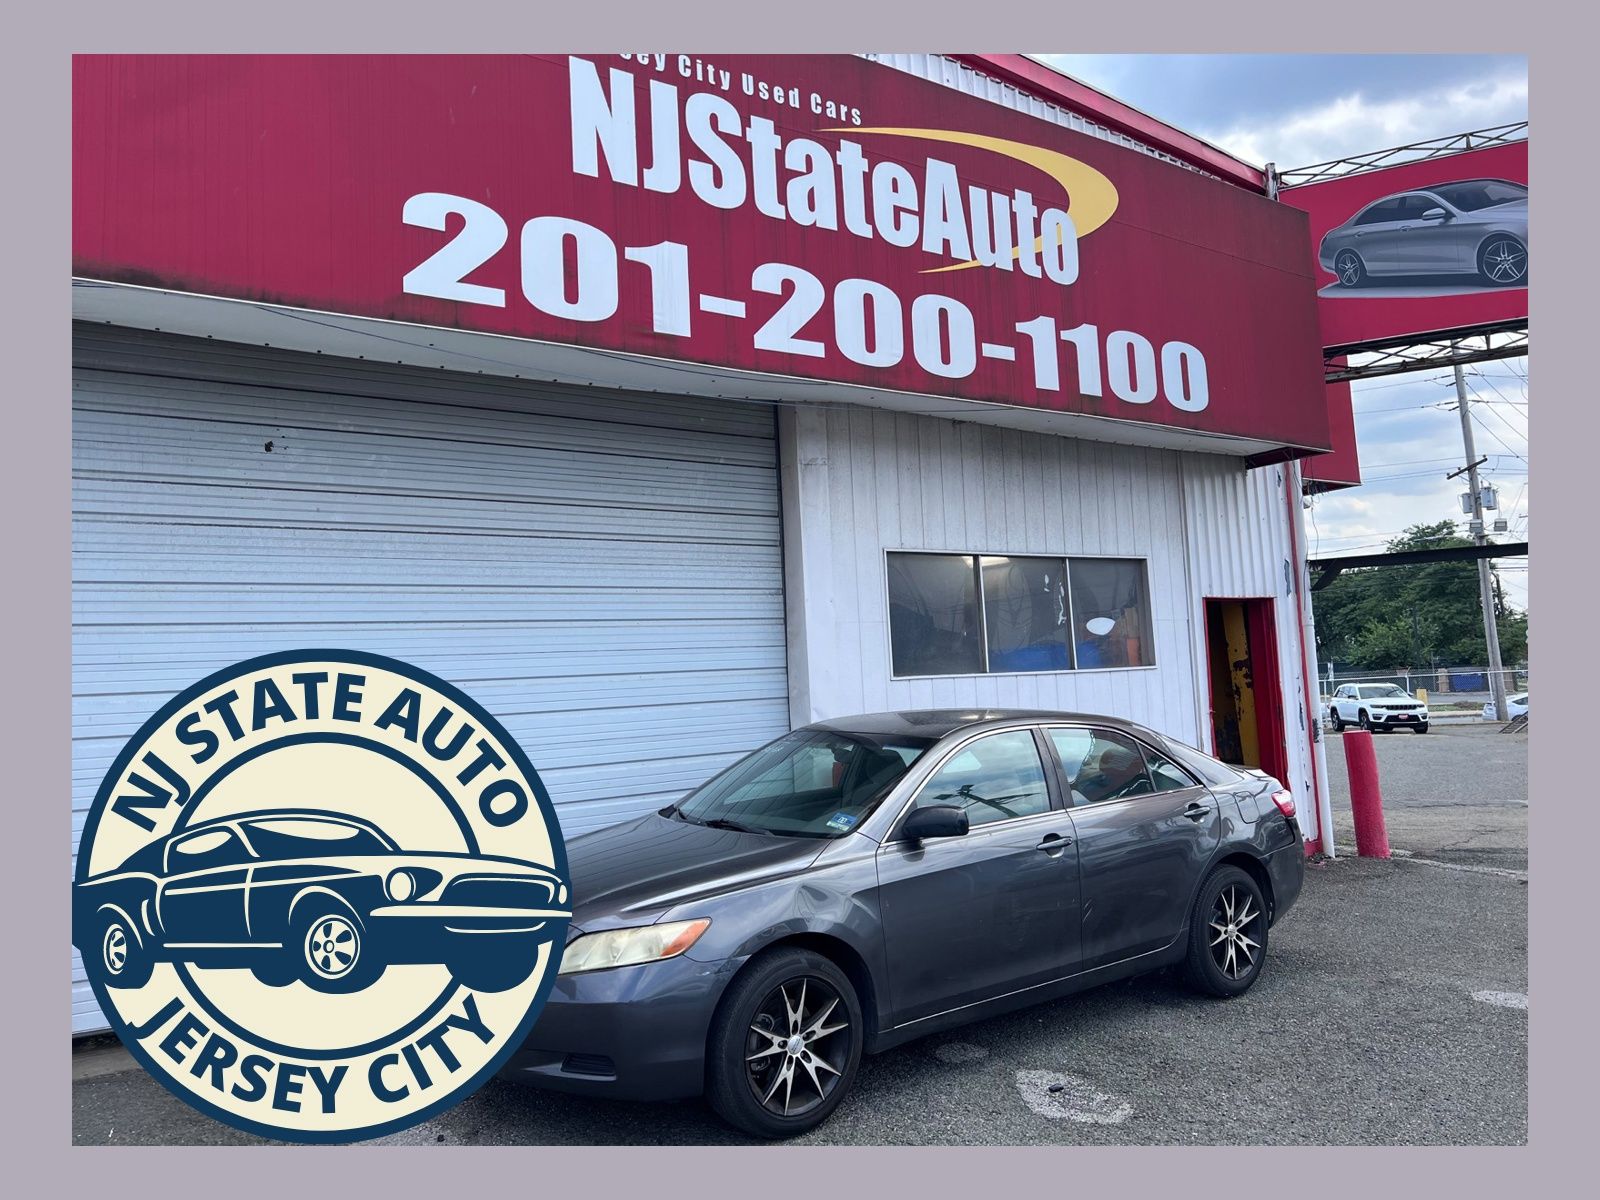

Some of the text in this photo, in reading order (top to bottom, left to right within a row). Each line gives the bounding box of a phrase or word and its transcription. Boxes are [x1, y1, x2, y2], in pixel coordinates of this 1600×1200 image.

[568, 55, 1080, 285] NJStateAuto
[678, 54, 731, 91] City
[741, 72, 800, 109] Used
[811, 92, 862, 126] Cars
[402, 192, 1209, 412] 201-200-1100
